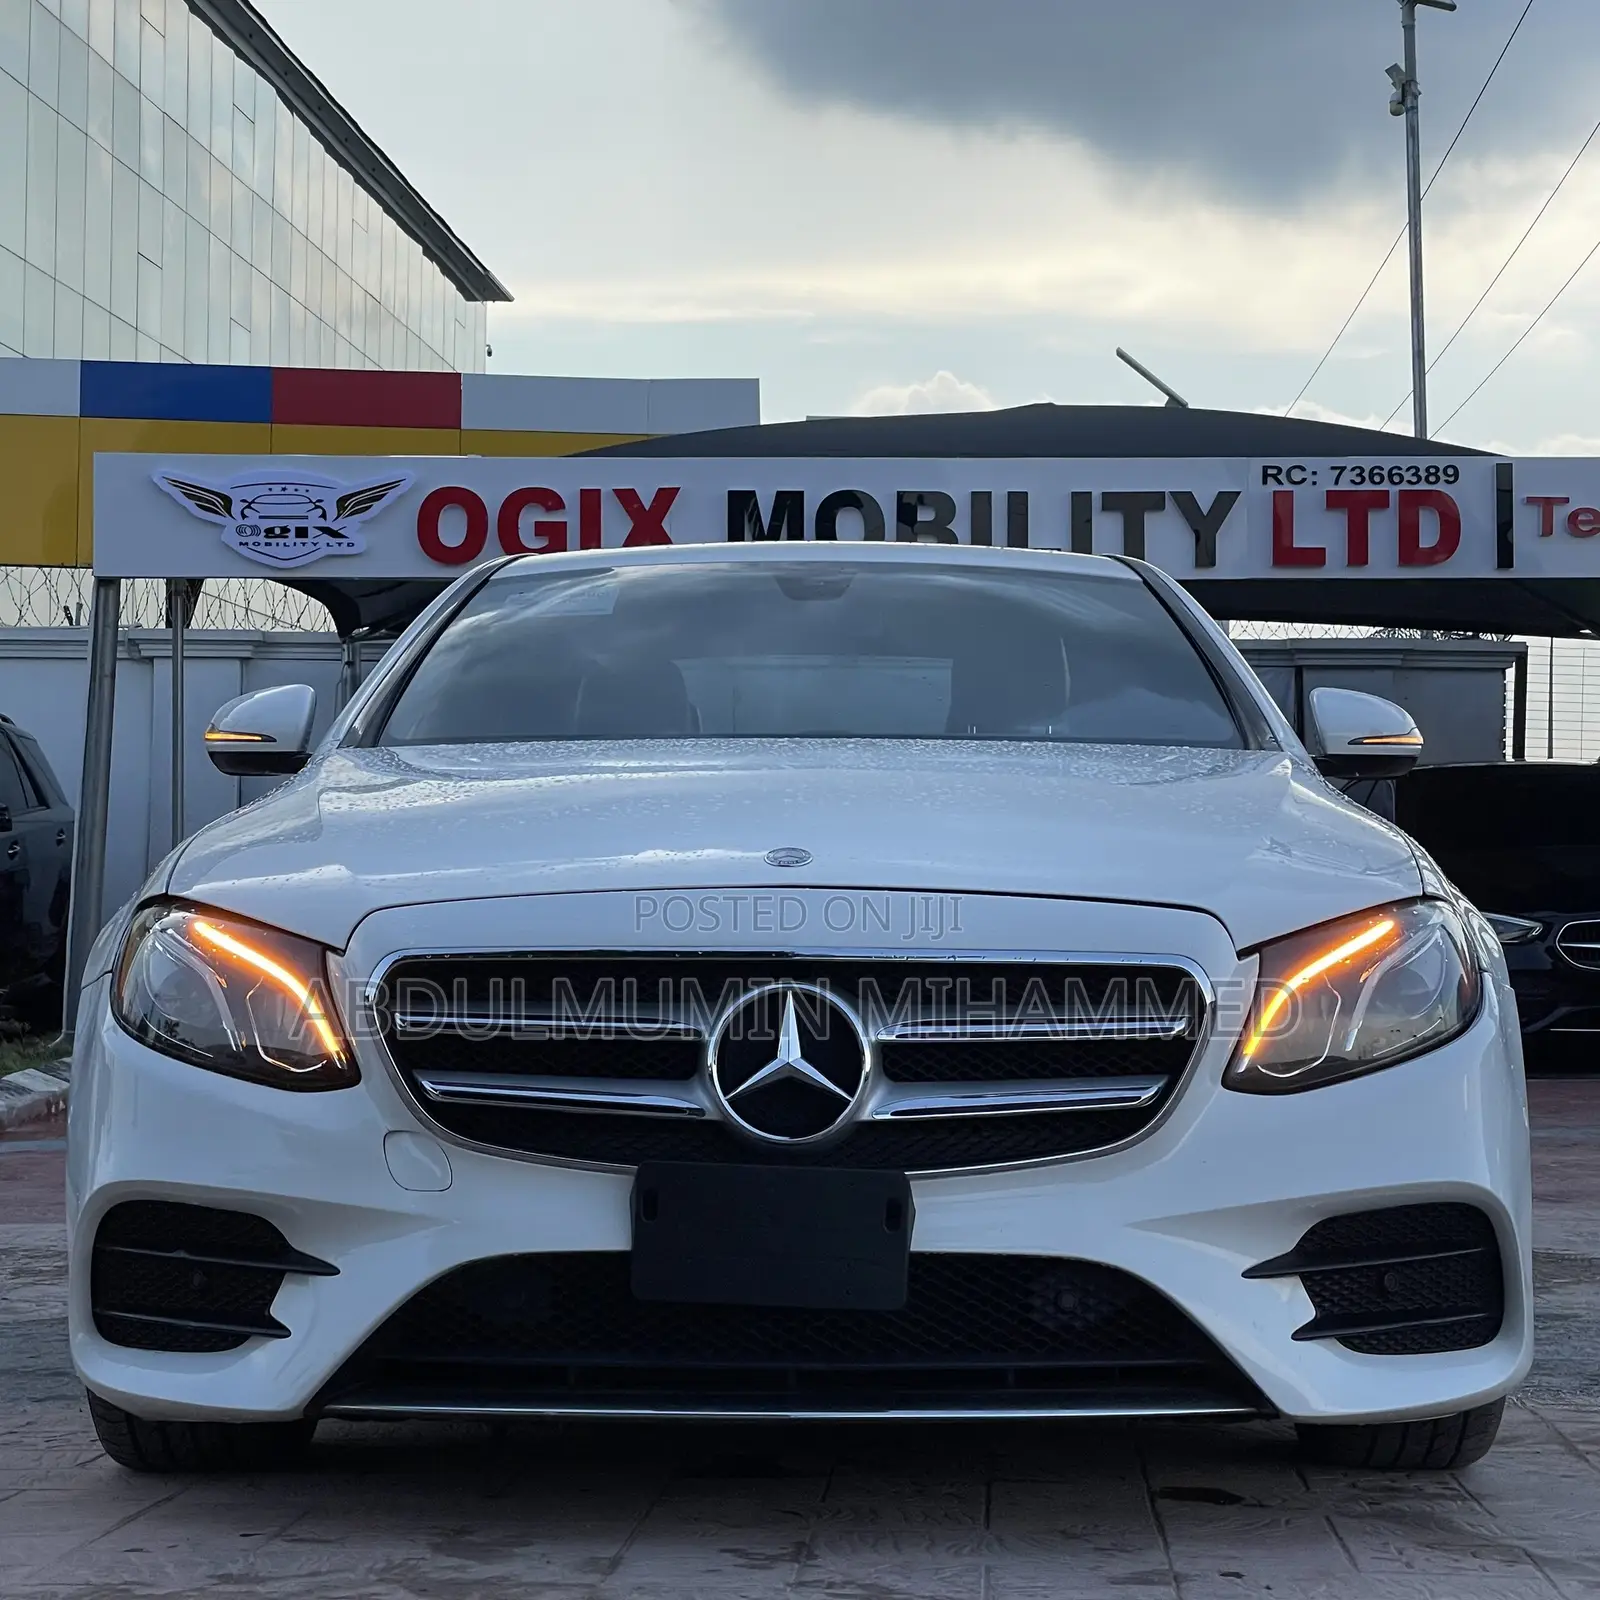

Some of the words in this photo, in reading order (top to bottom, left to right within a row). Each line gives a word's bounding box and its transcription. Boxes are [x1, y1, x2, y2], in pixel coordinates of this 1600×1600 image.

[1261, 464, 1318, 486] RC:
[1329, 464, 1460, 486] 7366389
[416, 485, 682, 566] OGIX
[726, 490, 1242, 569] MOBILITY
[1271, 489, 1462, 567] LTD
